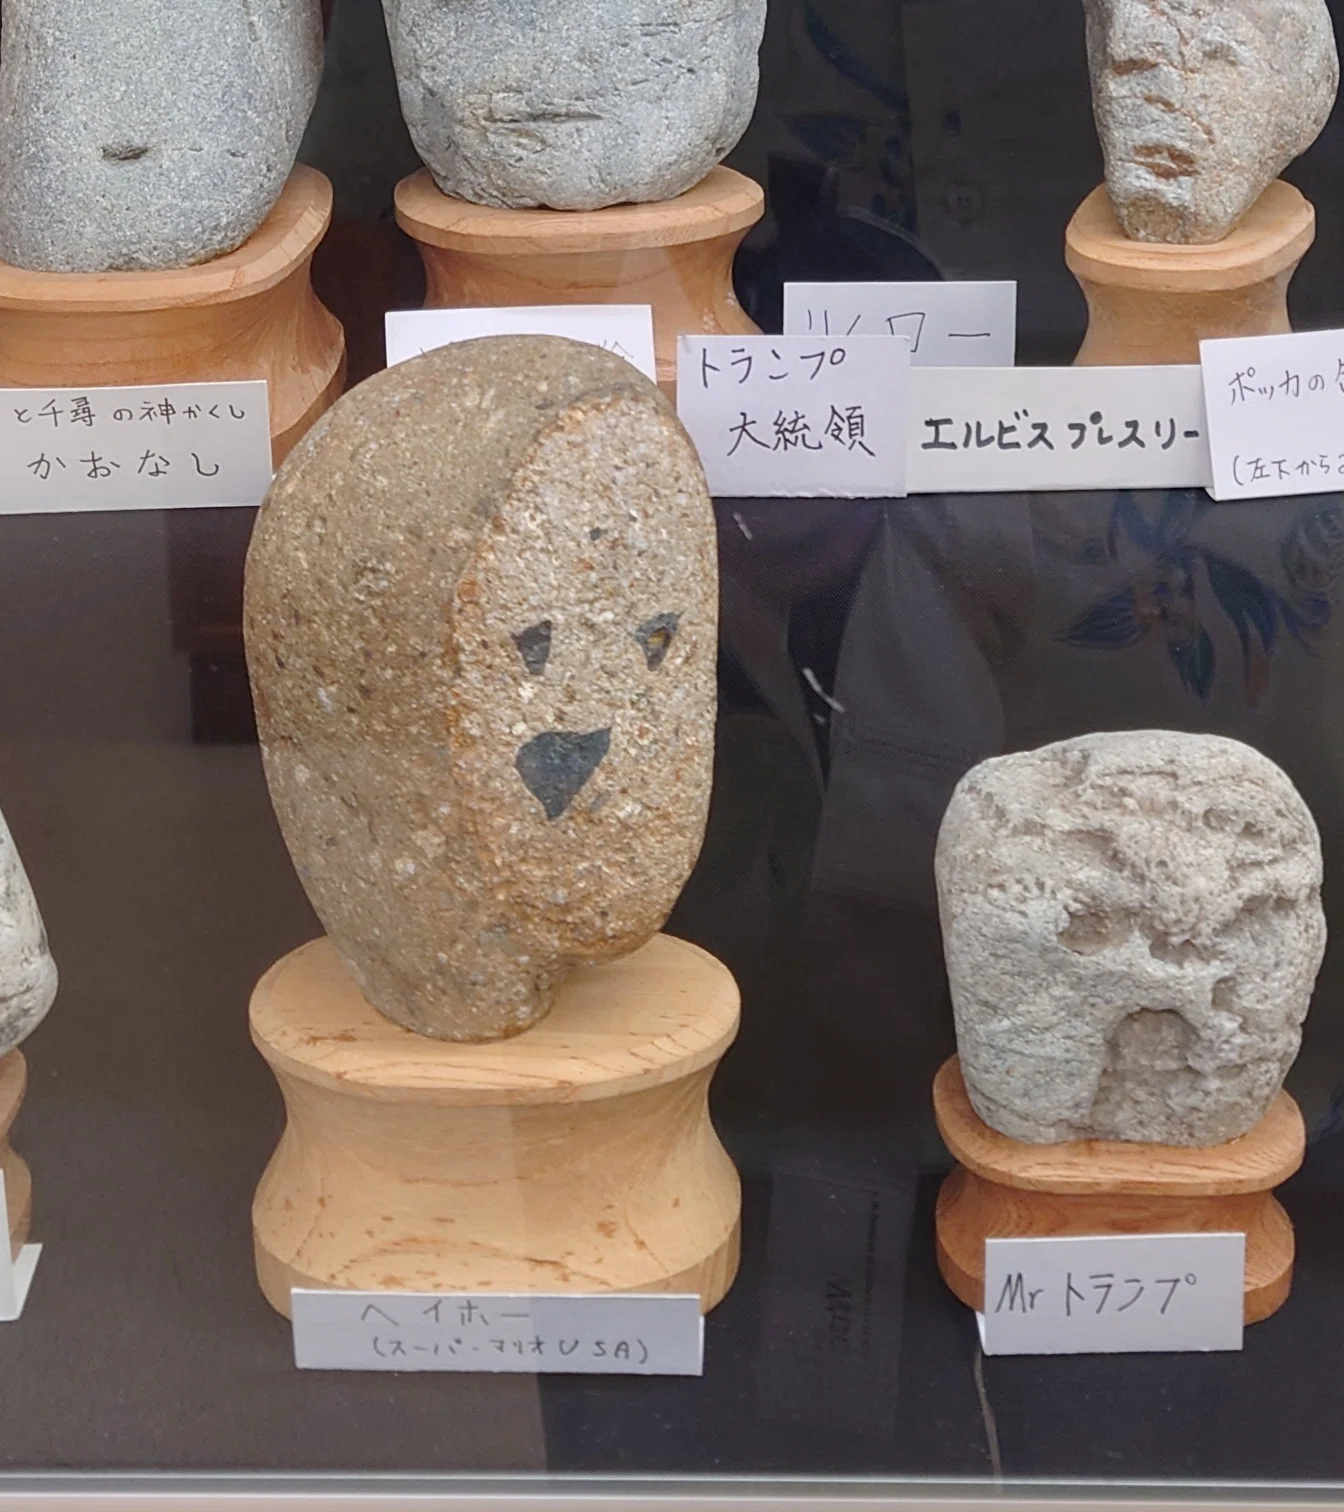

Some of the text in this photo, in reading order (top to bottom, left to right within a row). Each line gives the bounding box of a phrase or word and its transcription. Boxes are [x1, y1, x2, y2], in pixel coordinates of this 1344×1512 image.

[702, 348, 845, 389] トランプ
[727, 405, 876, 457] 大統領
[27, 449, 219, 479] かおなし
[361, 1299, 530, 1326] ヘイホー
[994, 1272, 1045, 1314] Mr
